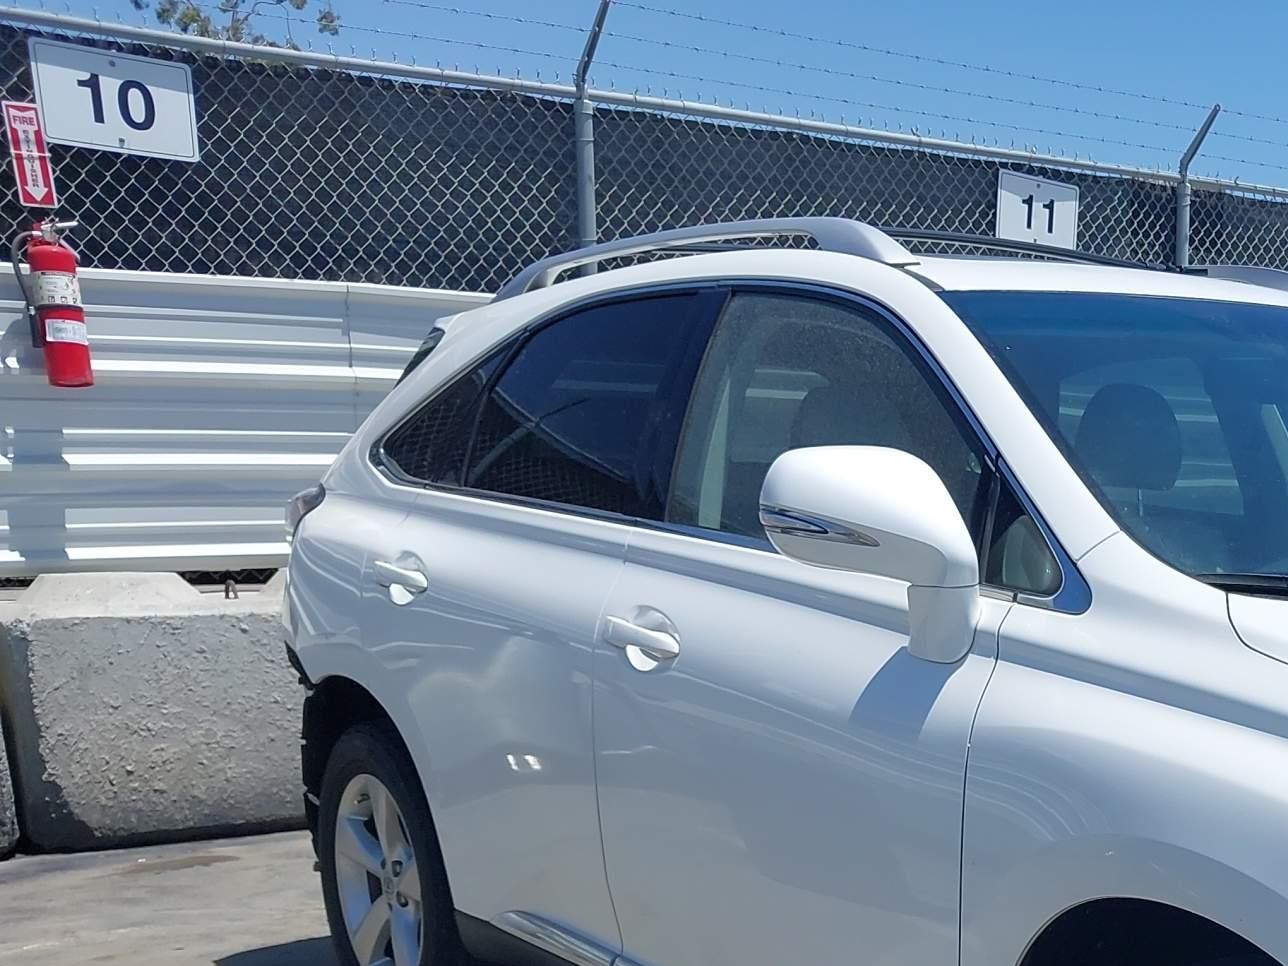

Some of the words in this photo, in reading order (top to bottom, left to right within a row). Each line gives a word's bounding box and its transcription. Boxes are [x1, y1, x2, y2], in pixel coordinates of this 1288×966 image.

[12, 115, 36, 127] FIRE
[76, 73, 155, 132] 10
[1022, 194, 1055, 234] 11
